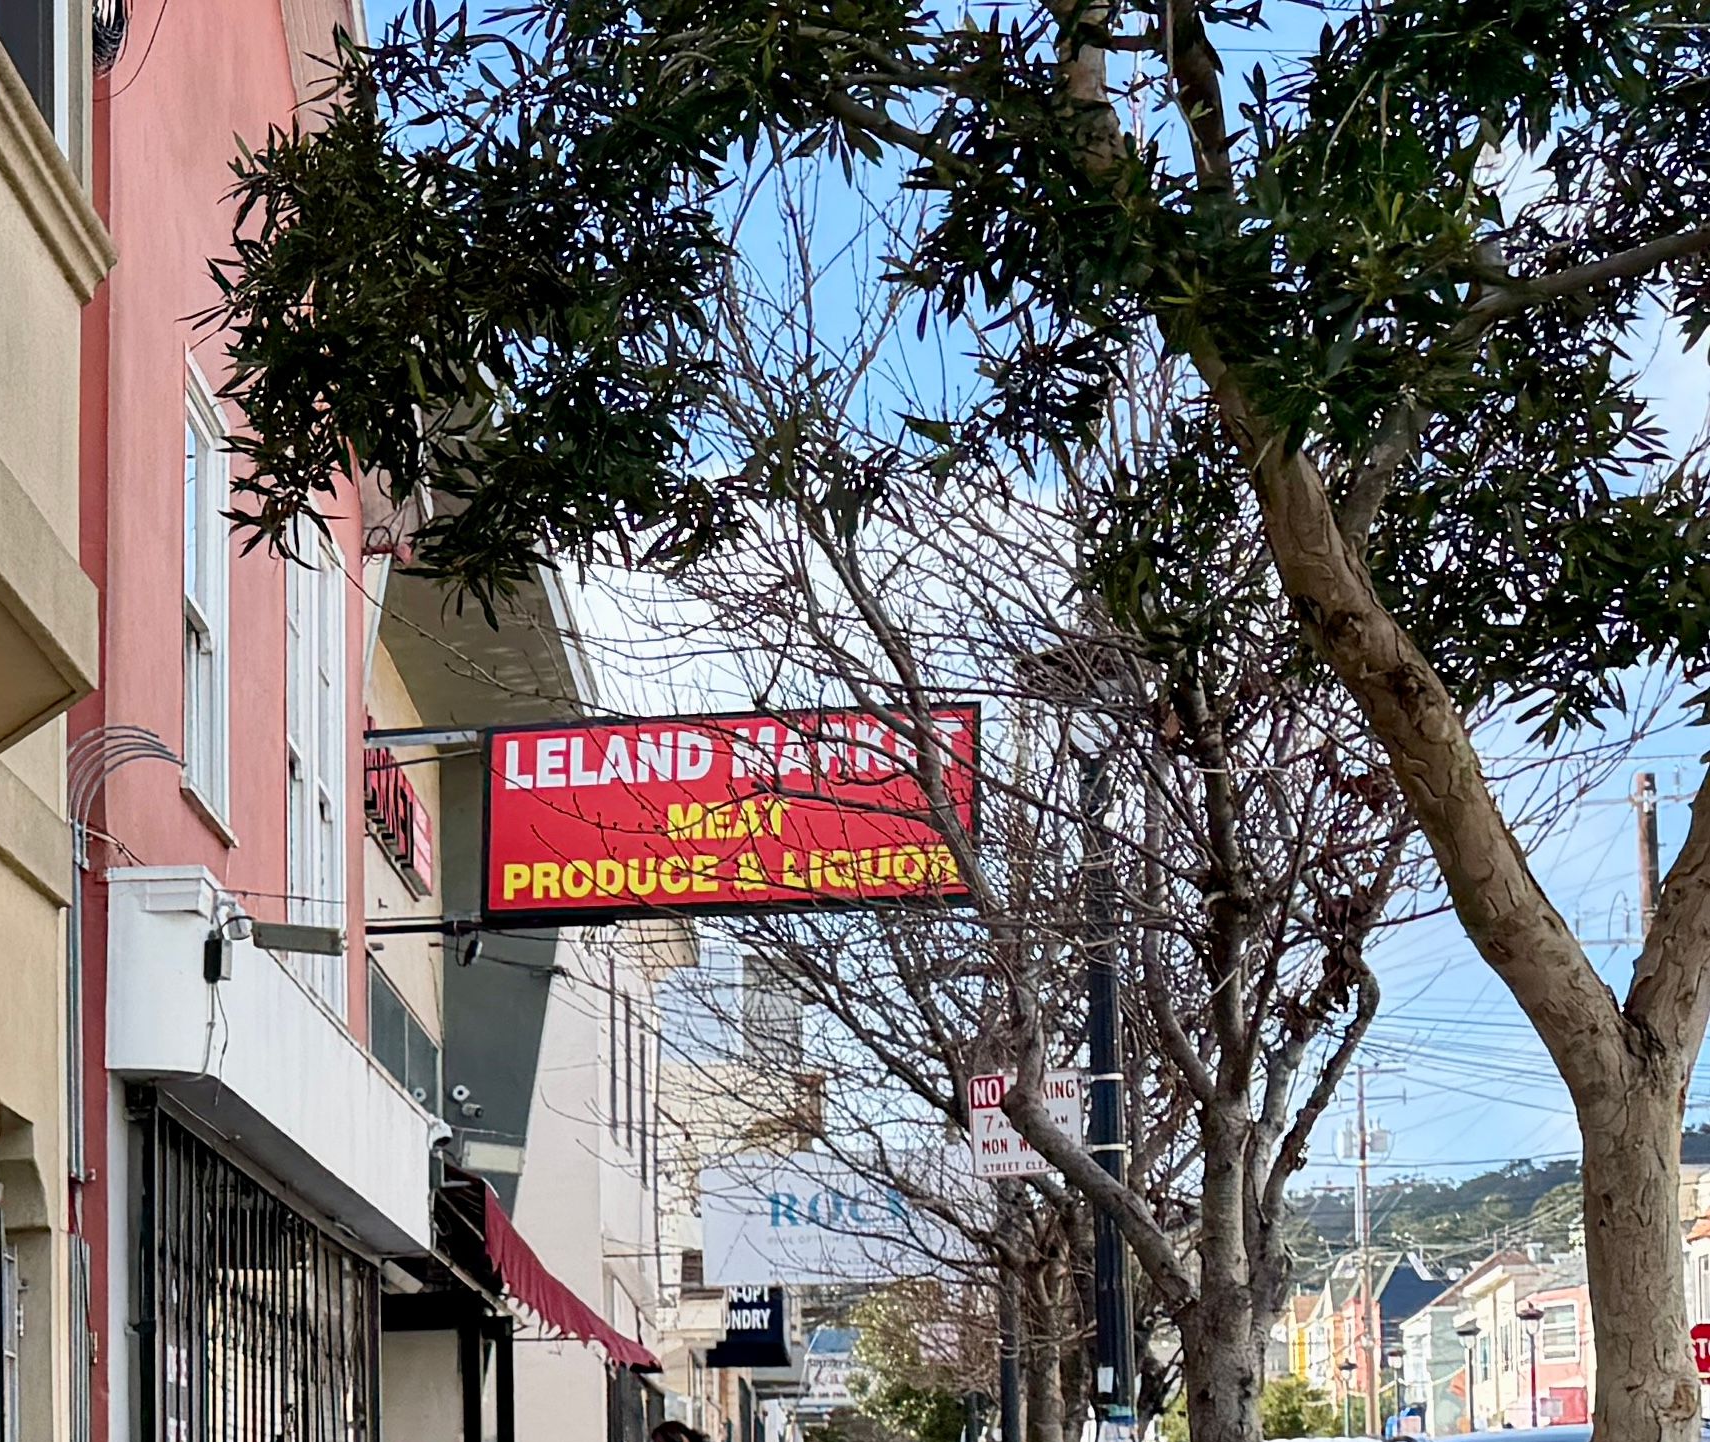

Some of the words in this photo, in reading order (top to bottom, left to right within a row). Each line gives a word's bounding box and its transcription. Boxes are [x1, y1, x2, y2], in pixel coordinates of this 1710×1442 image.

[504, 730, 713, 790] LELAND
[667, 799, 790, 841] MEAT
[503, 855, 719, 900] PRODUCE
[783, 844, 961, 890] LIQUOR
[973, 1079, 1001, 1107] NO
[983, 1114, 994, 1133] 7
[982, 1138, 1008, 1155] MON
[983, 1161, 1019, 1173] STREET
